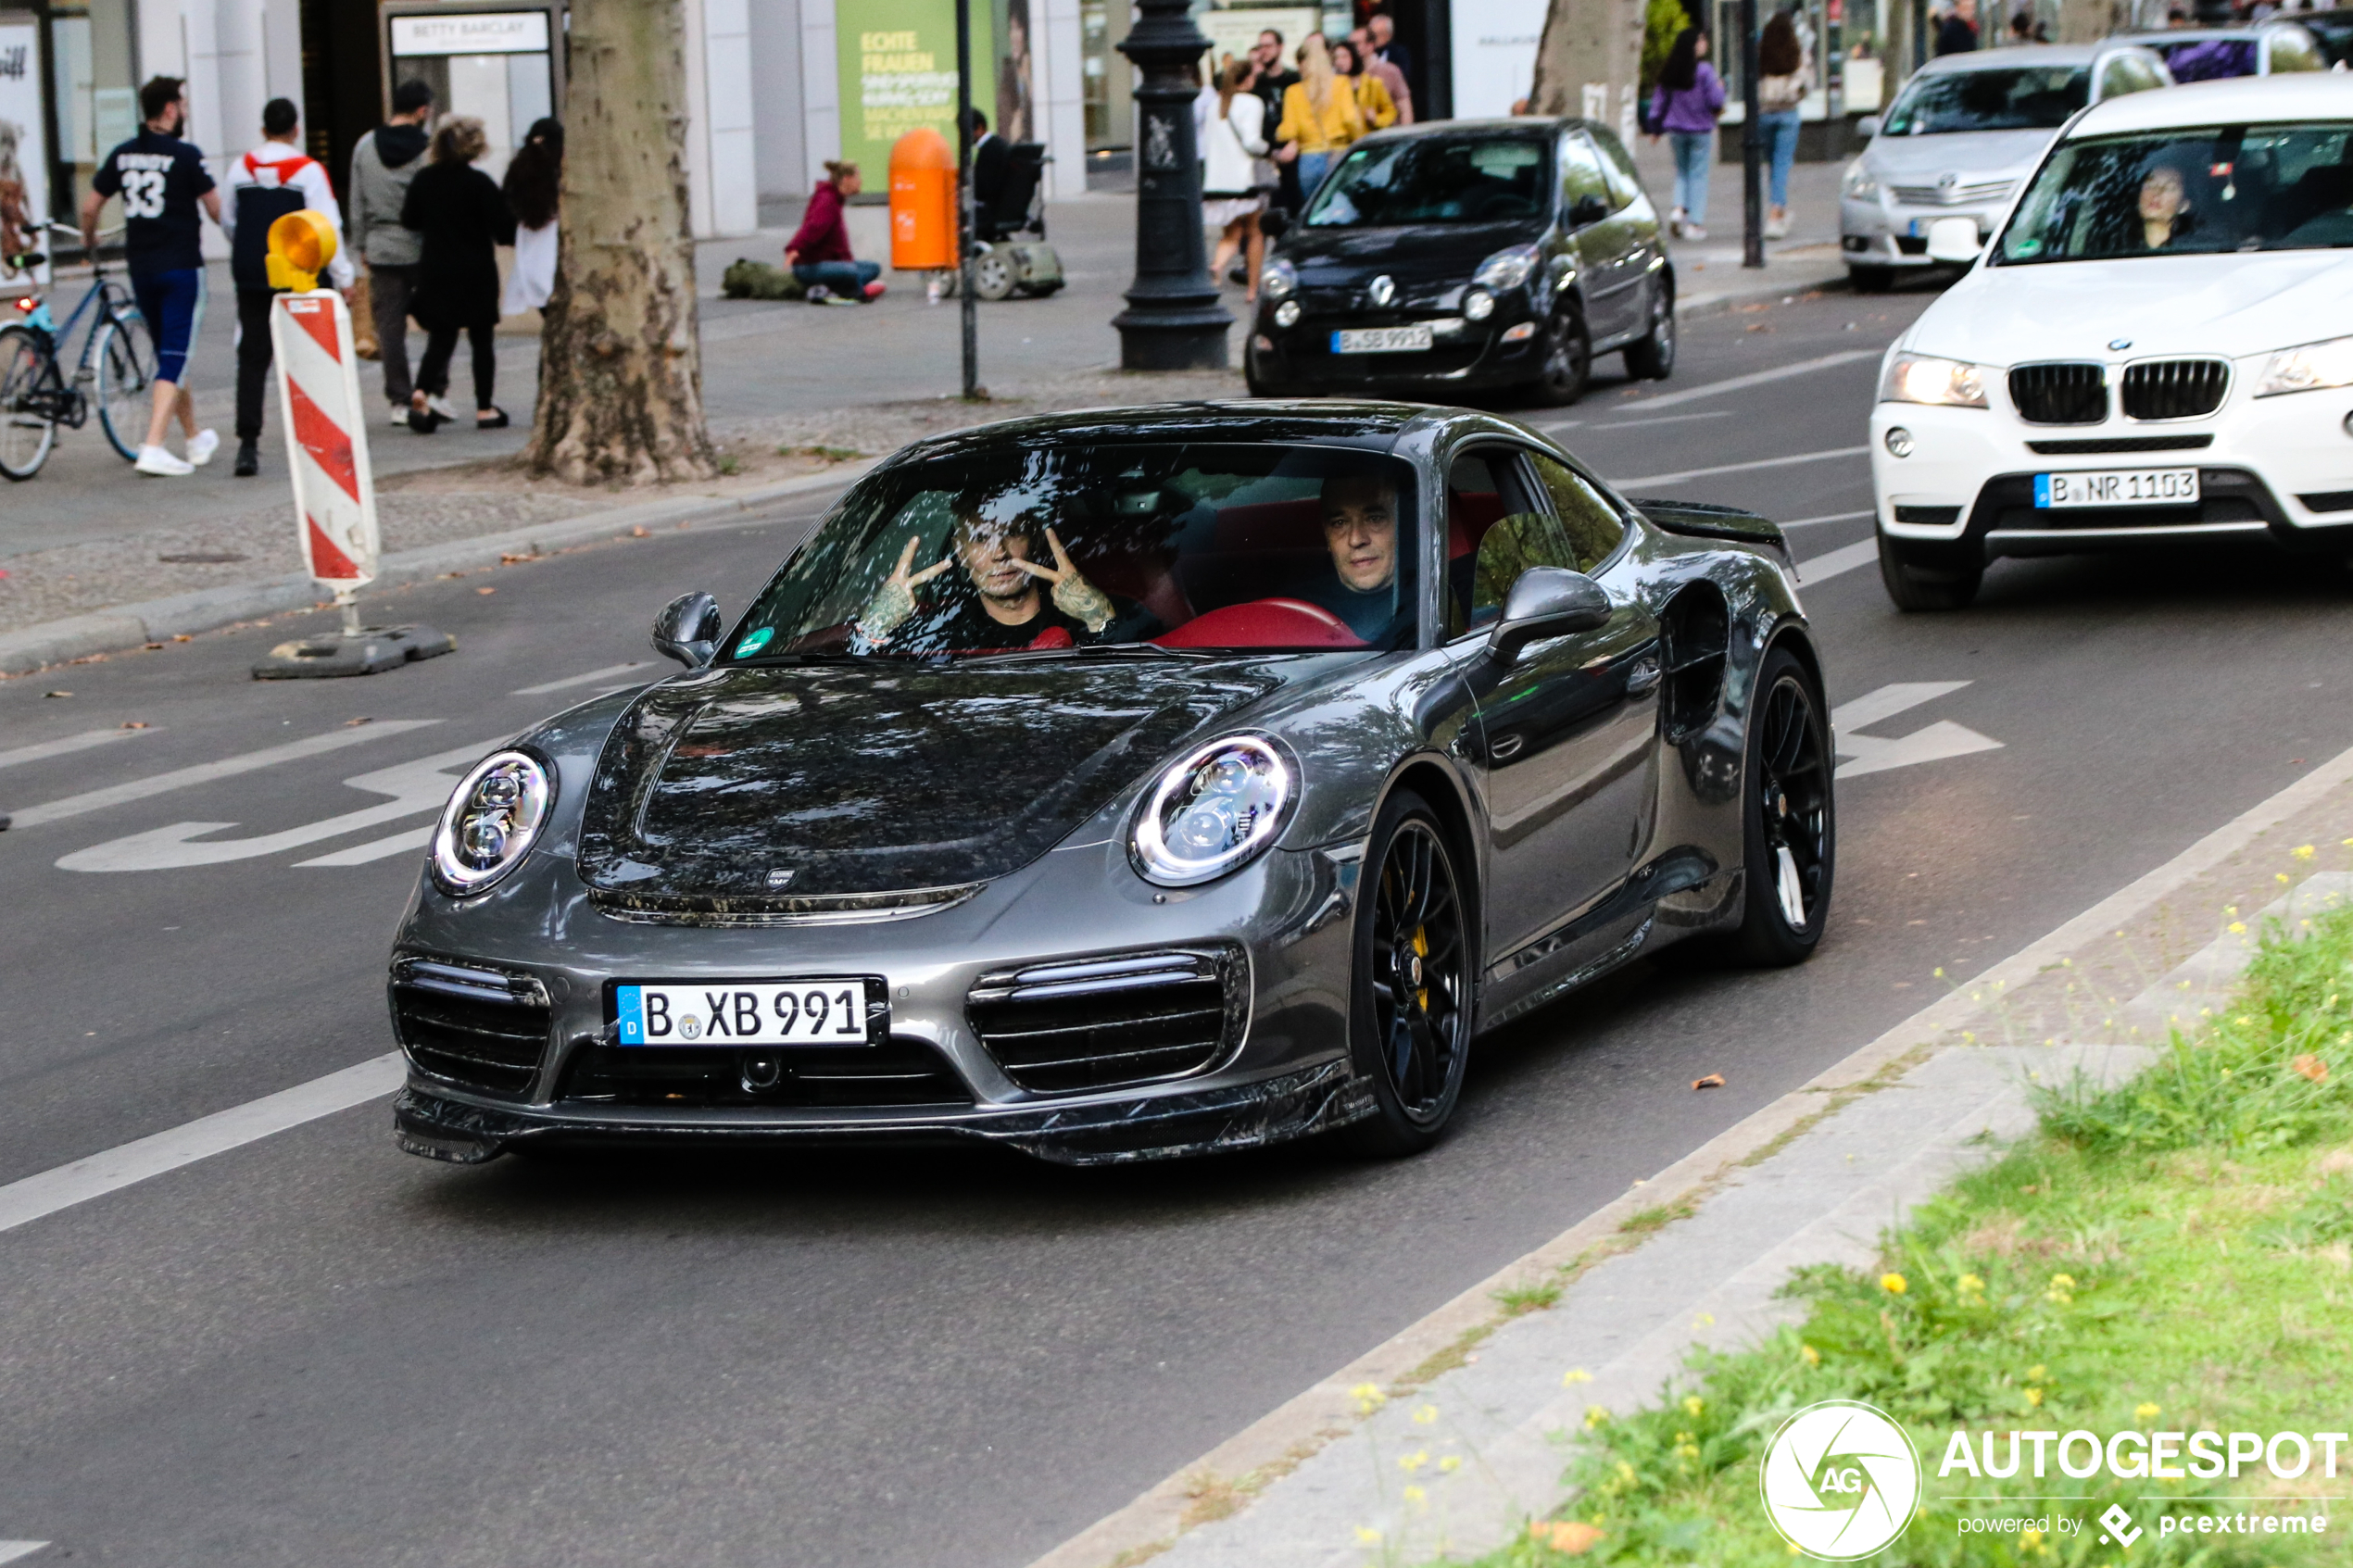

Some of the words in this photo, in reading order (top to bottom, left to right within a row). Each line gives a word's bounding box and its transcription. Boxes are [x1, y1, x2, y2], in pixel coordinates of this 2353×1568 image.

[413, 23, 455, 37] BETTY
[460, 20, 524, 35] BARCLAY
[861, 31, 916, 52] ECHTE
[862, 51, 934, 72] FRAUEN
[121, 170, 166, 219] 33
[1387, 328, 1428, 347] 9912
[2053, 478, 2068, 502] B
[2087, 476, 2120, 501] NR
[2128, 472, 2194, 499] 1103
[646, 992, 673, 1036] B
[705, 991, 762, 1036] XB
[774, 990, 862, 1035] 991
[627, 1022, 637, 1035] D
